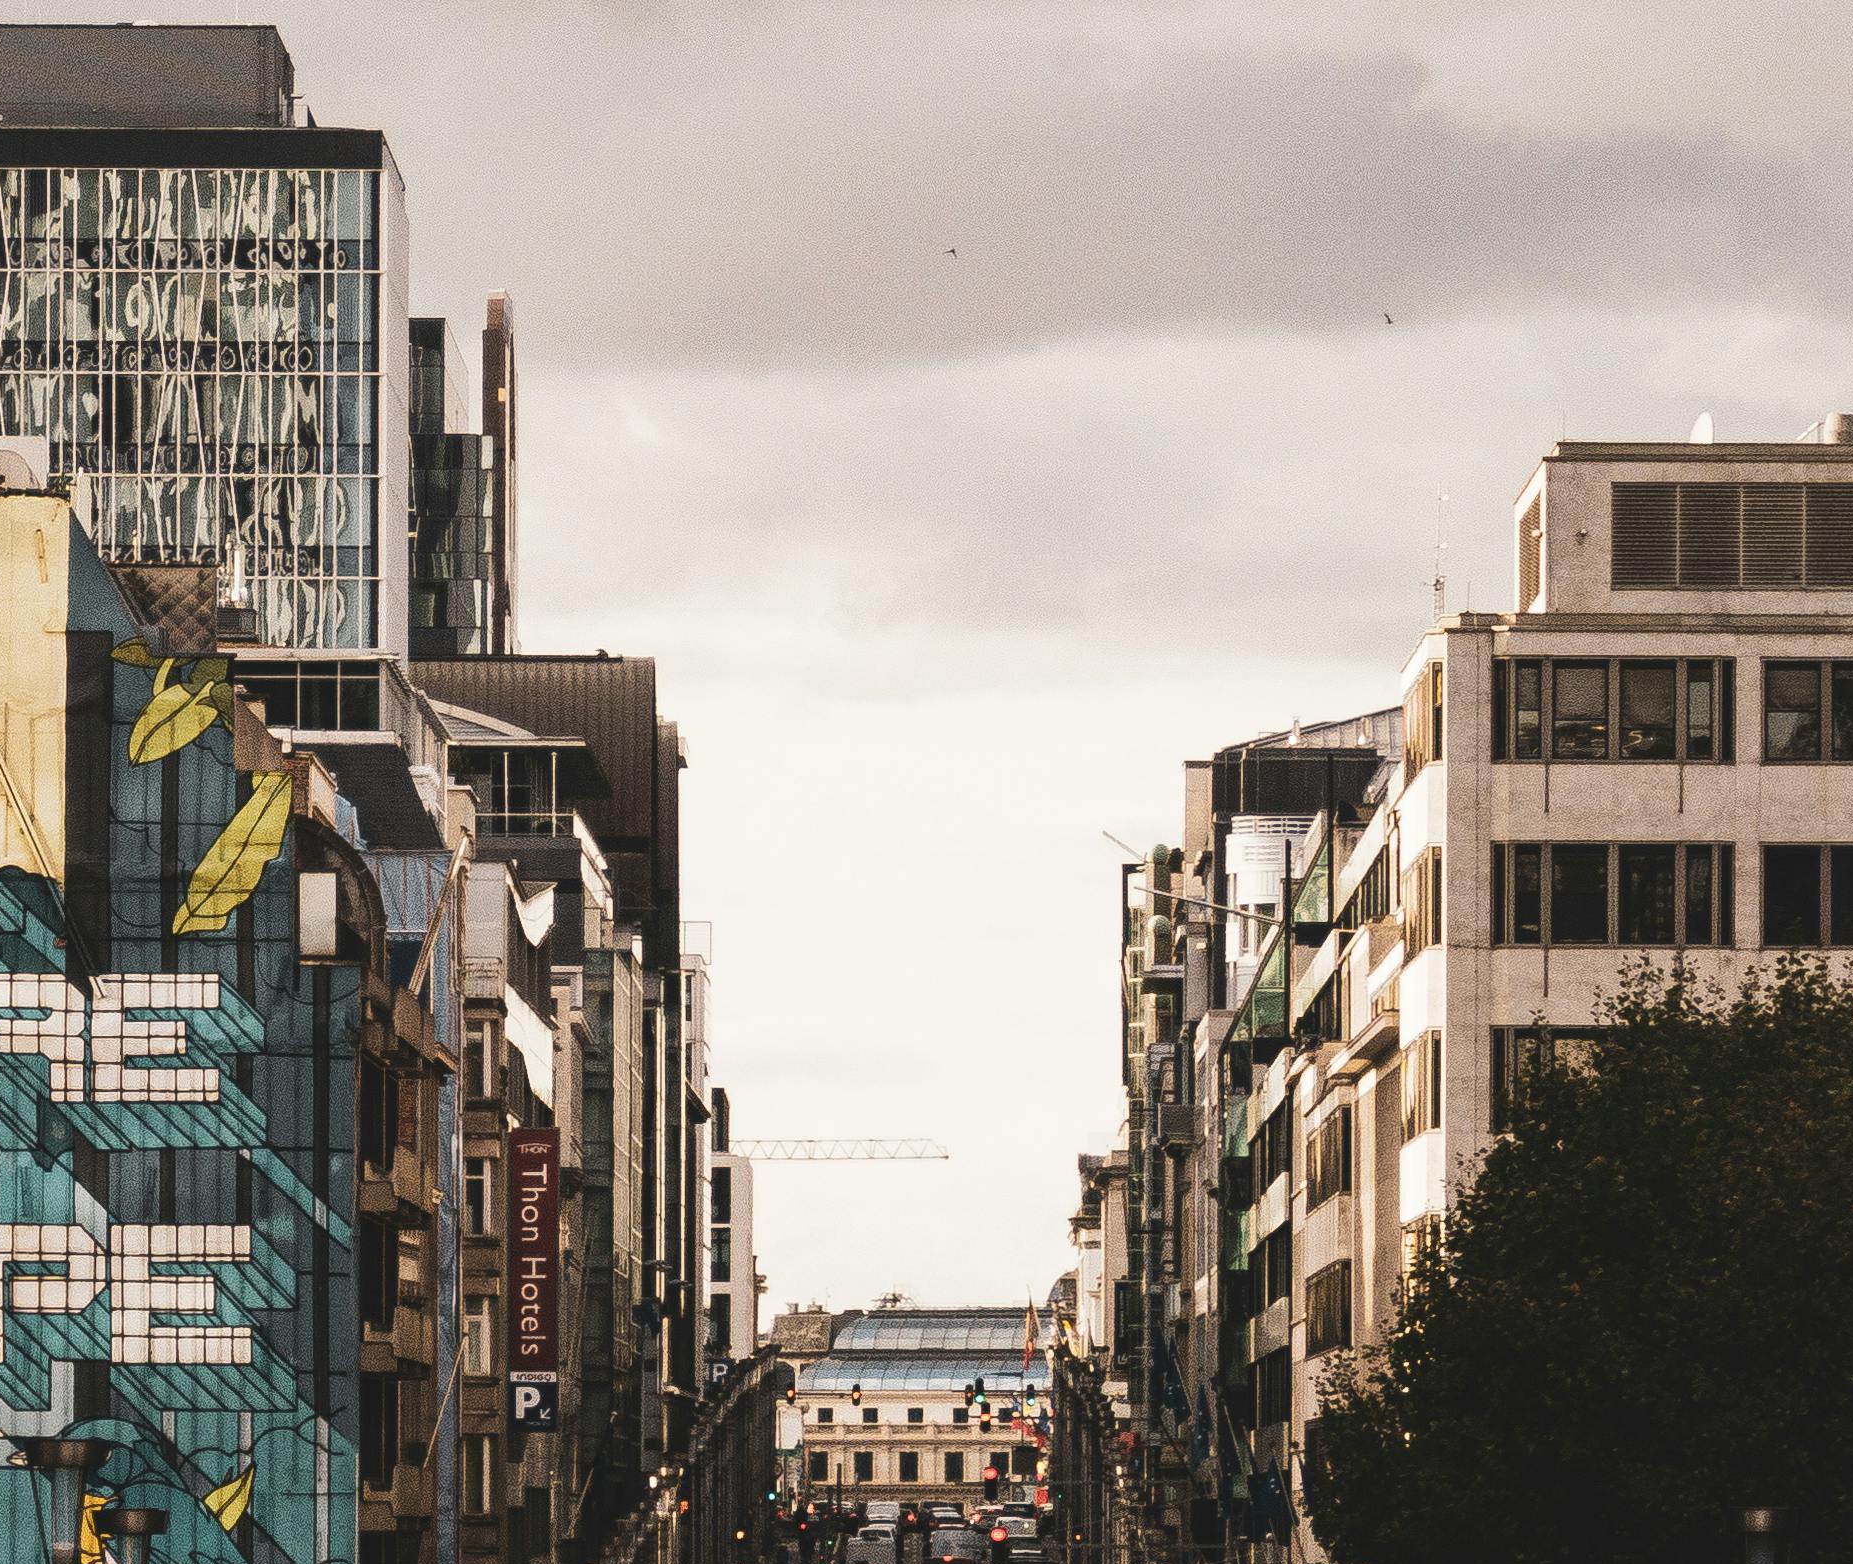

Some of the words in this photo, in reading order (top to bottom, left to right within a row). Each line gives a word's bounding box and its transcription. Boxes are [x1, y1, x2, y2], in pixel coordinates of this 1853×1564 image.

[522, 1163, 547, 1242] Thon
[521, 1257, 547, 1356] Hotels
[515, 1386, 541, 1419] P
